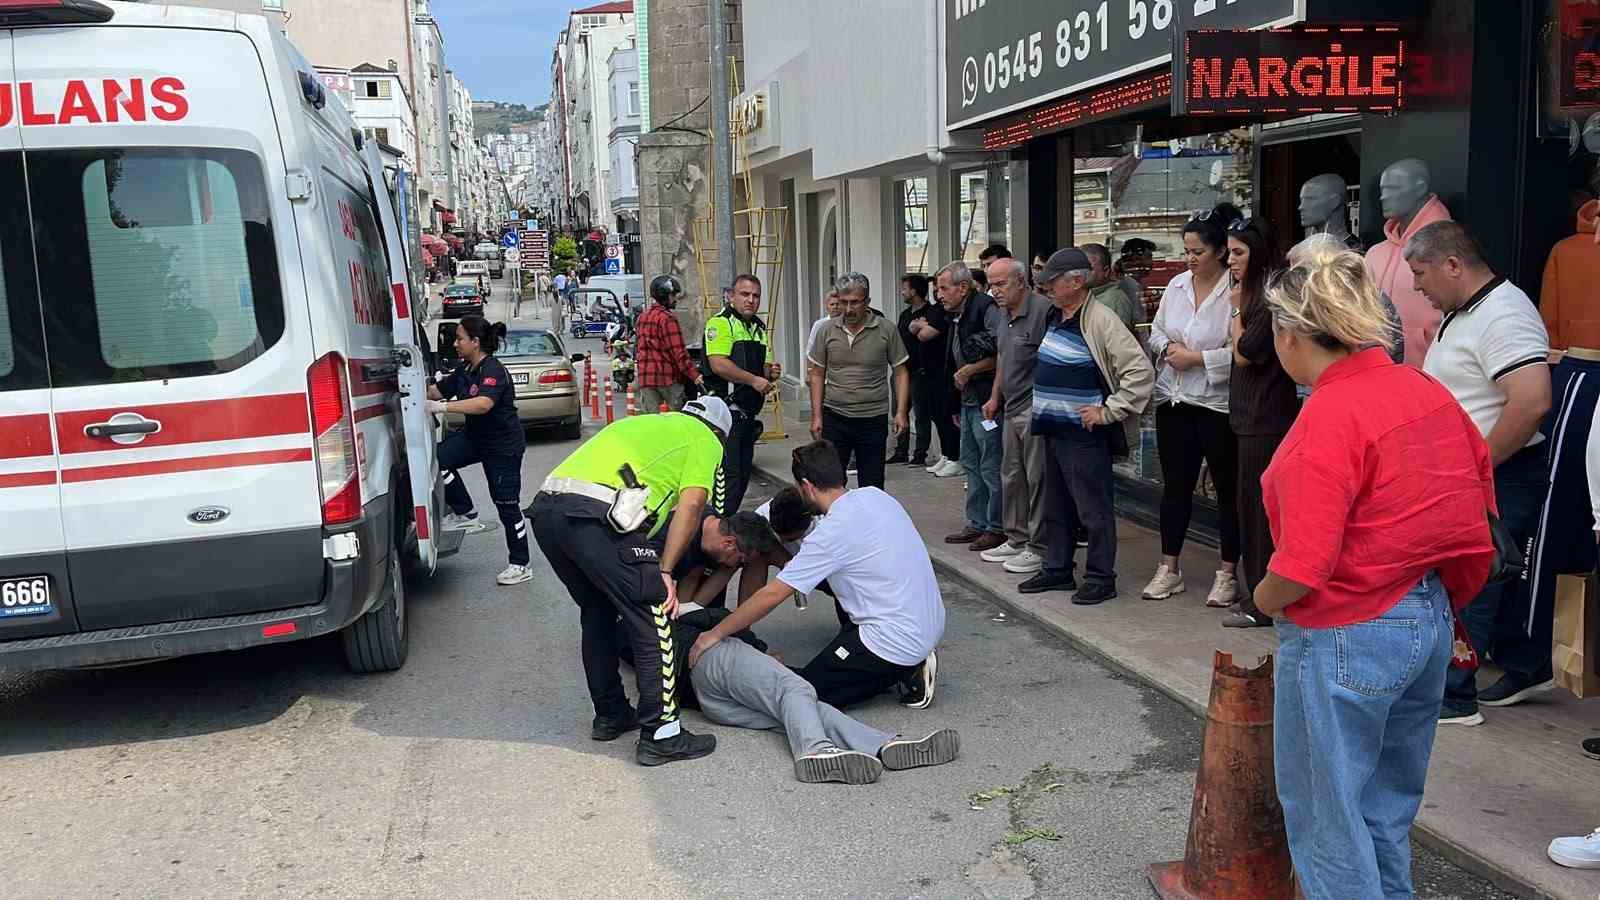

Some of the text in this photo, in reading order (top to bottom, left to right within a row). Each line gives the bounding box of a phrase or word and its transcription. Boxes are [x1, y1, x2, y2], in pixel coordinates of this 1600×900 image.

[984, 0, 1173, 94] 0545 831 58
[1191, 43, 1396, 97] NARGİLE
[2, 579, 45, 607] 666
